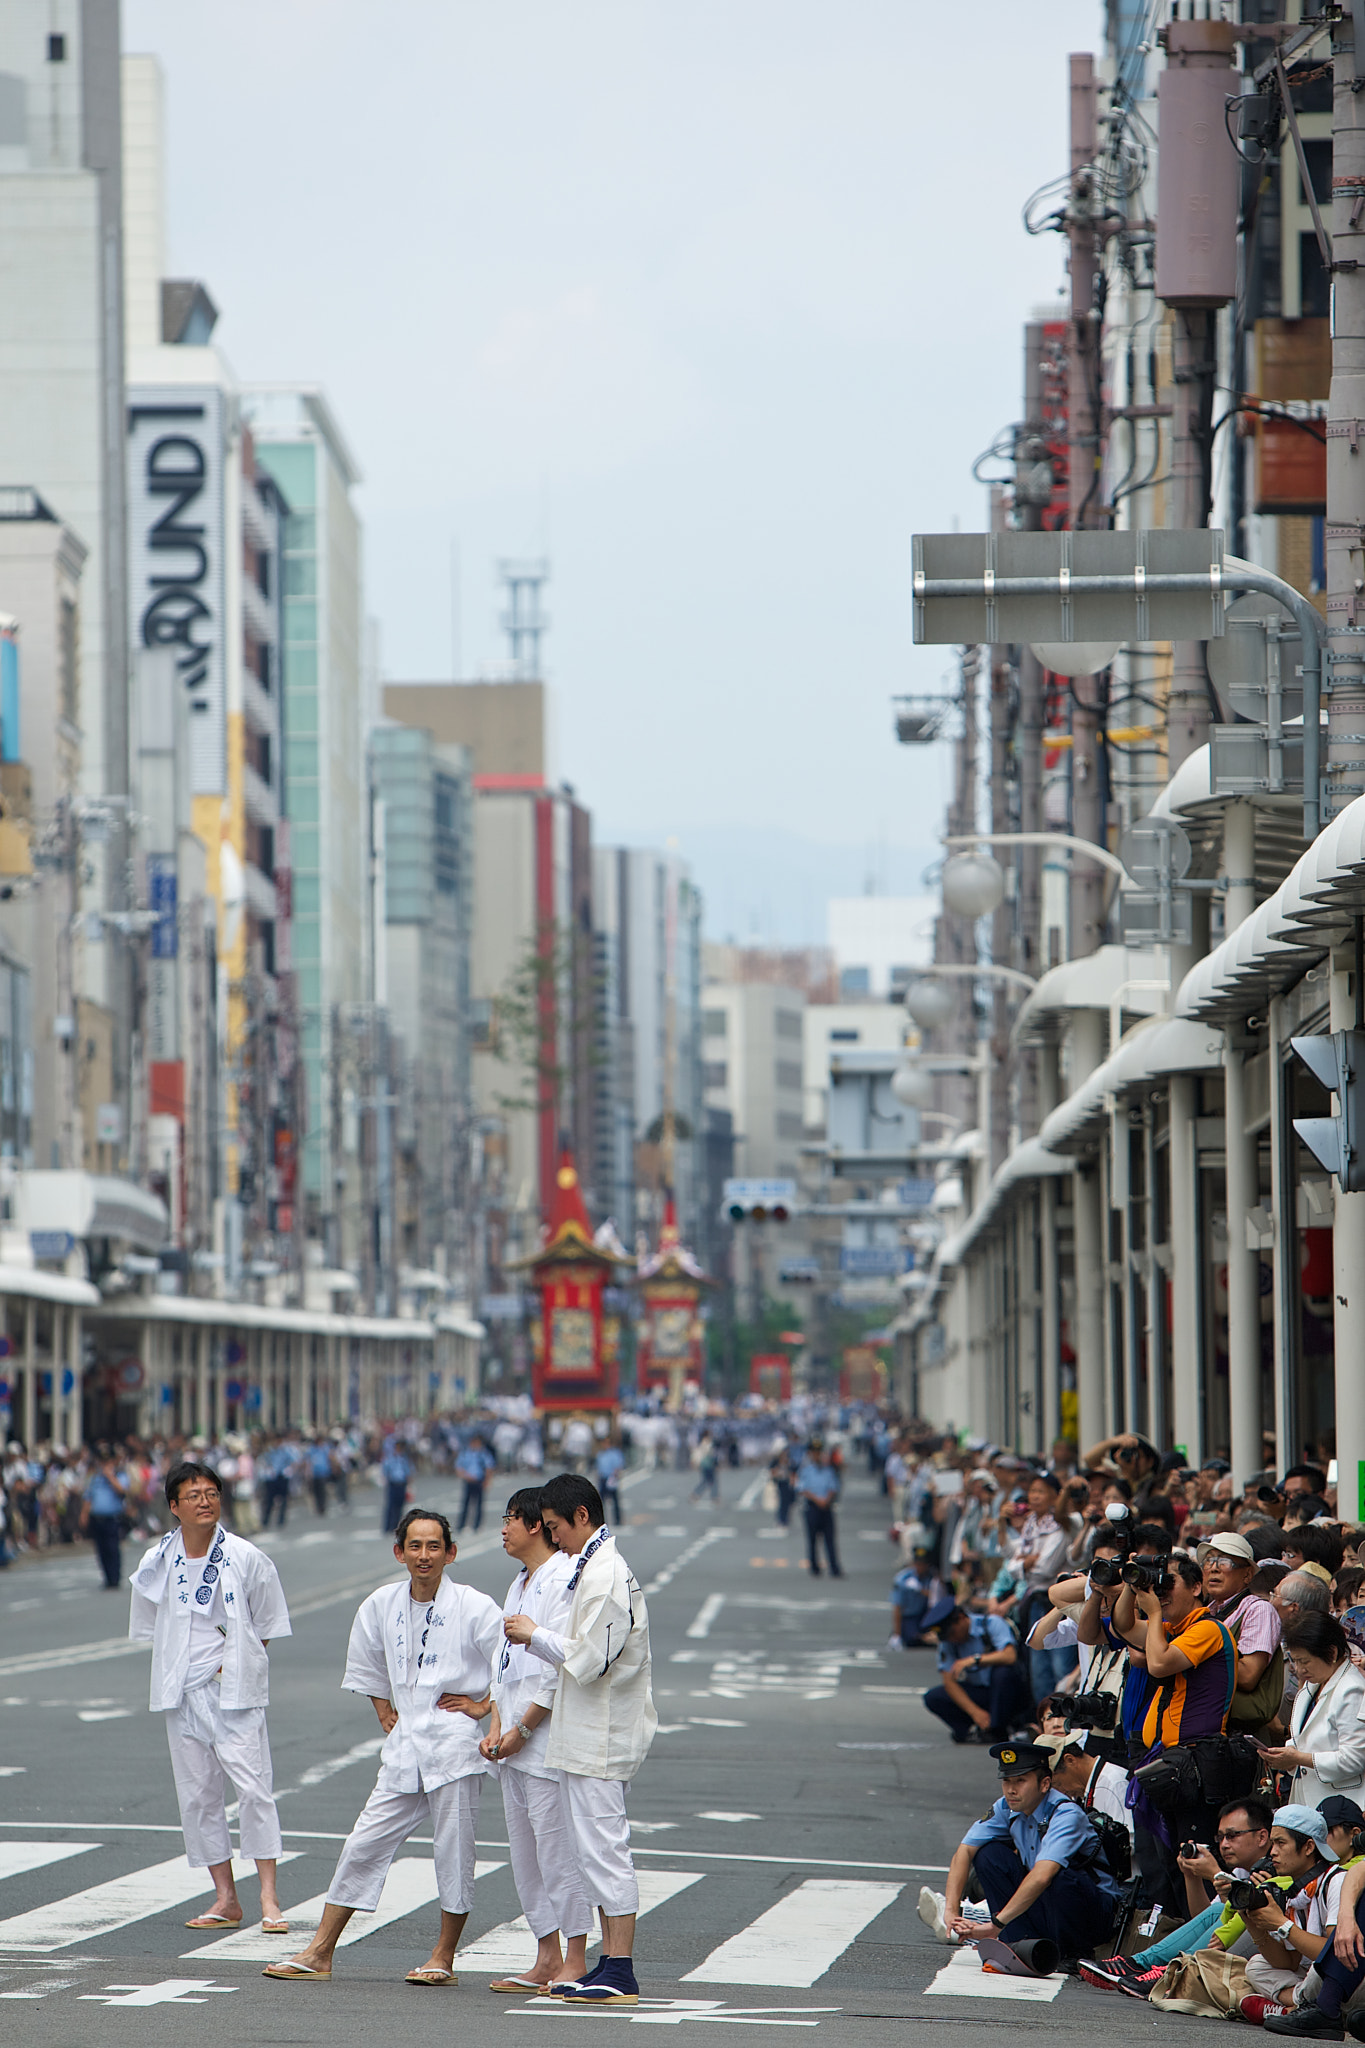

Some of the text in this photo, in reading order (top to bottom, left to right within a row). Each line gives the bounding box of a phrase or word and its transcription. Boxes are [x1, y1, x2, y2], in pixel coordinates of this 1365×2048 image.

[174, 1553, 189, 1604] 大工方
[396, 1610, 405, 1669] 大工方
